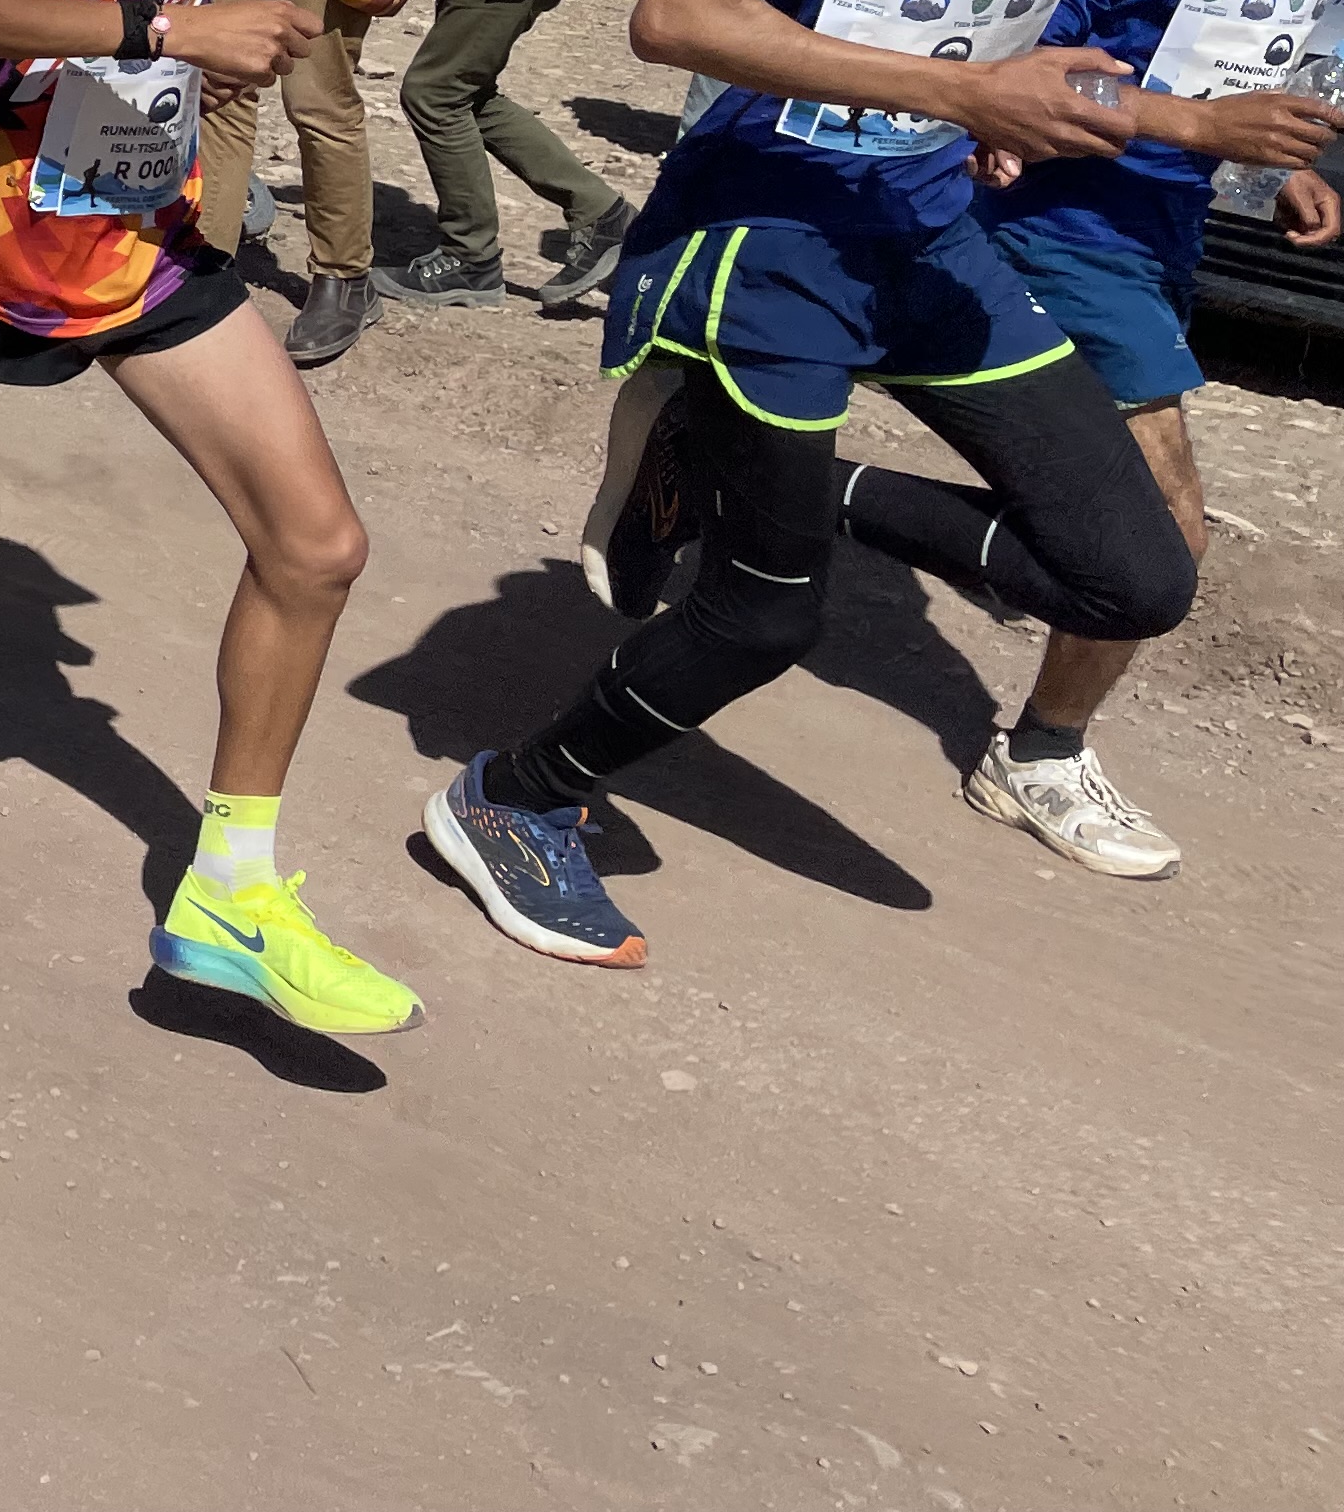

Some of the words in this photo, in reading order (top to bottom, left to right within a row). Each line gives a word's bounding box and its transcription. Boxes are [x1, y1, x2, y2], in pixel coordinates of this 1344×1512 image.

[1213, 59, 1273, 77] RUNNING
[99, 125, 159, 137] RUNNING
[111, 140, 169, 154] ISLI-TISLIT
[114, 161, 131, 179] R
